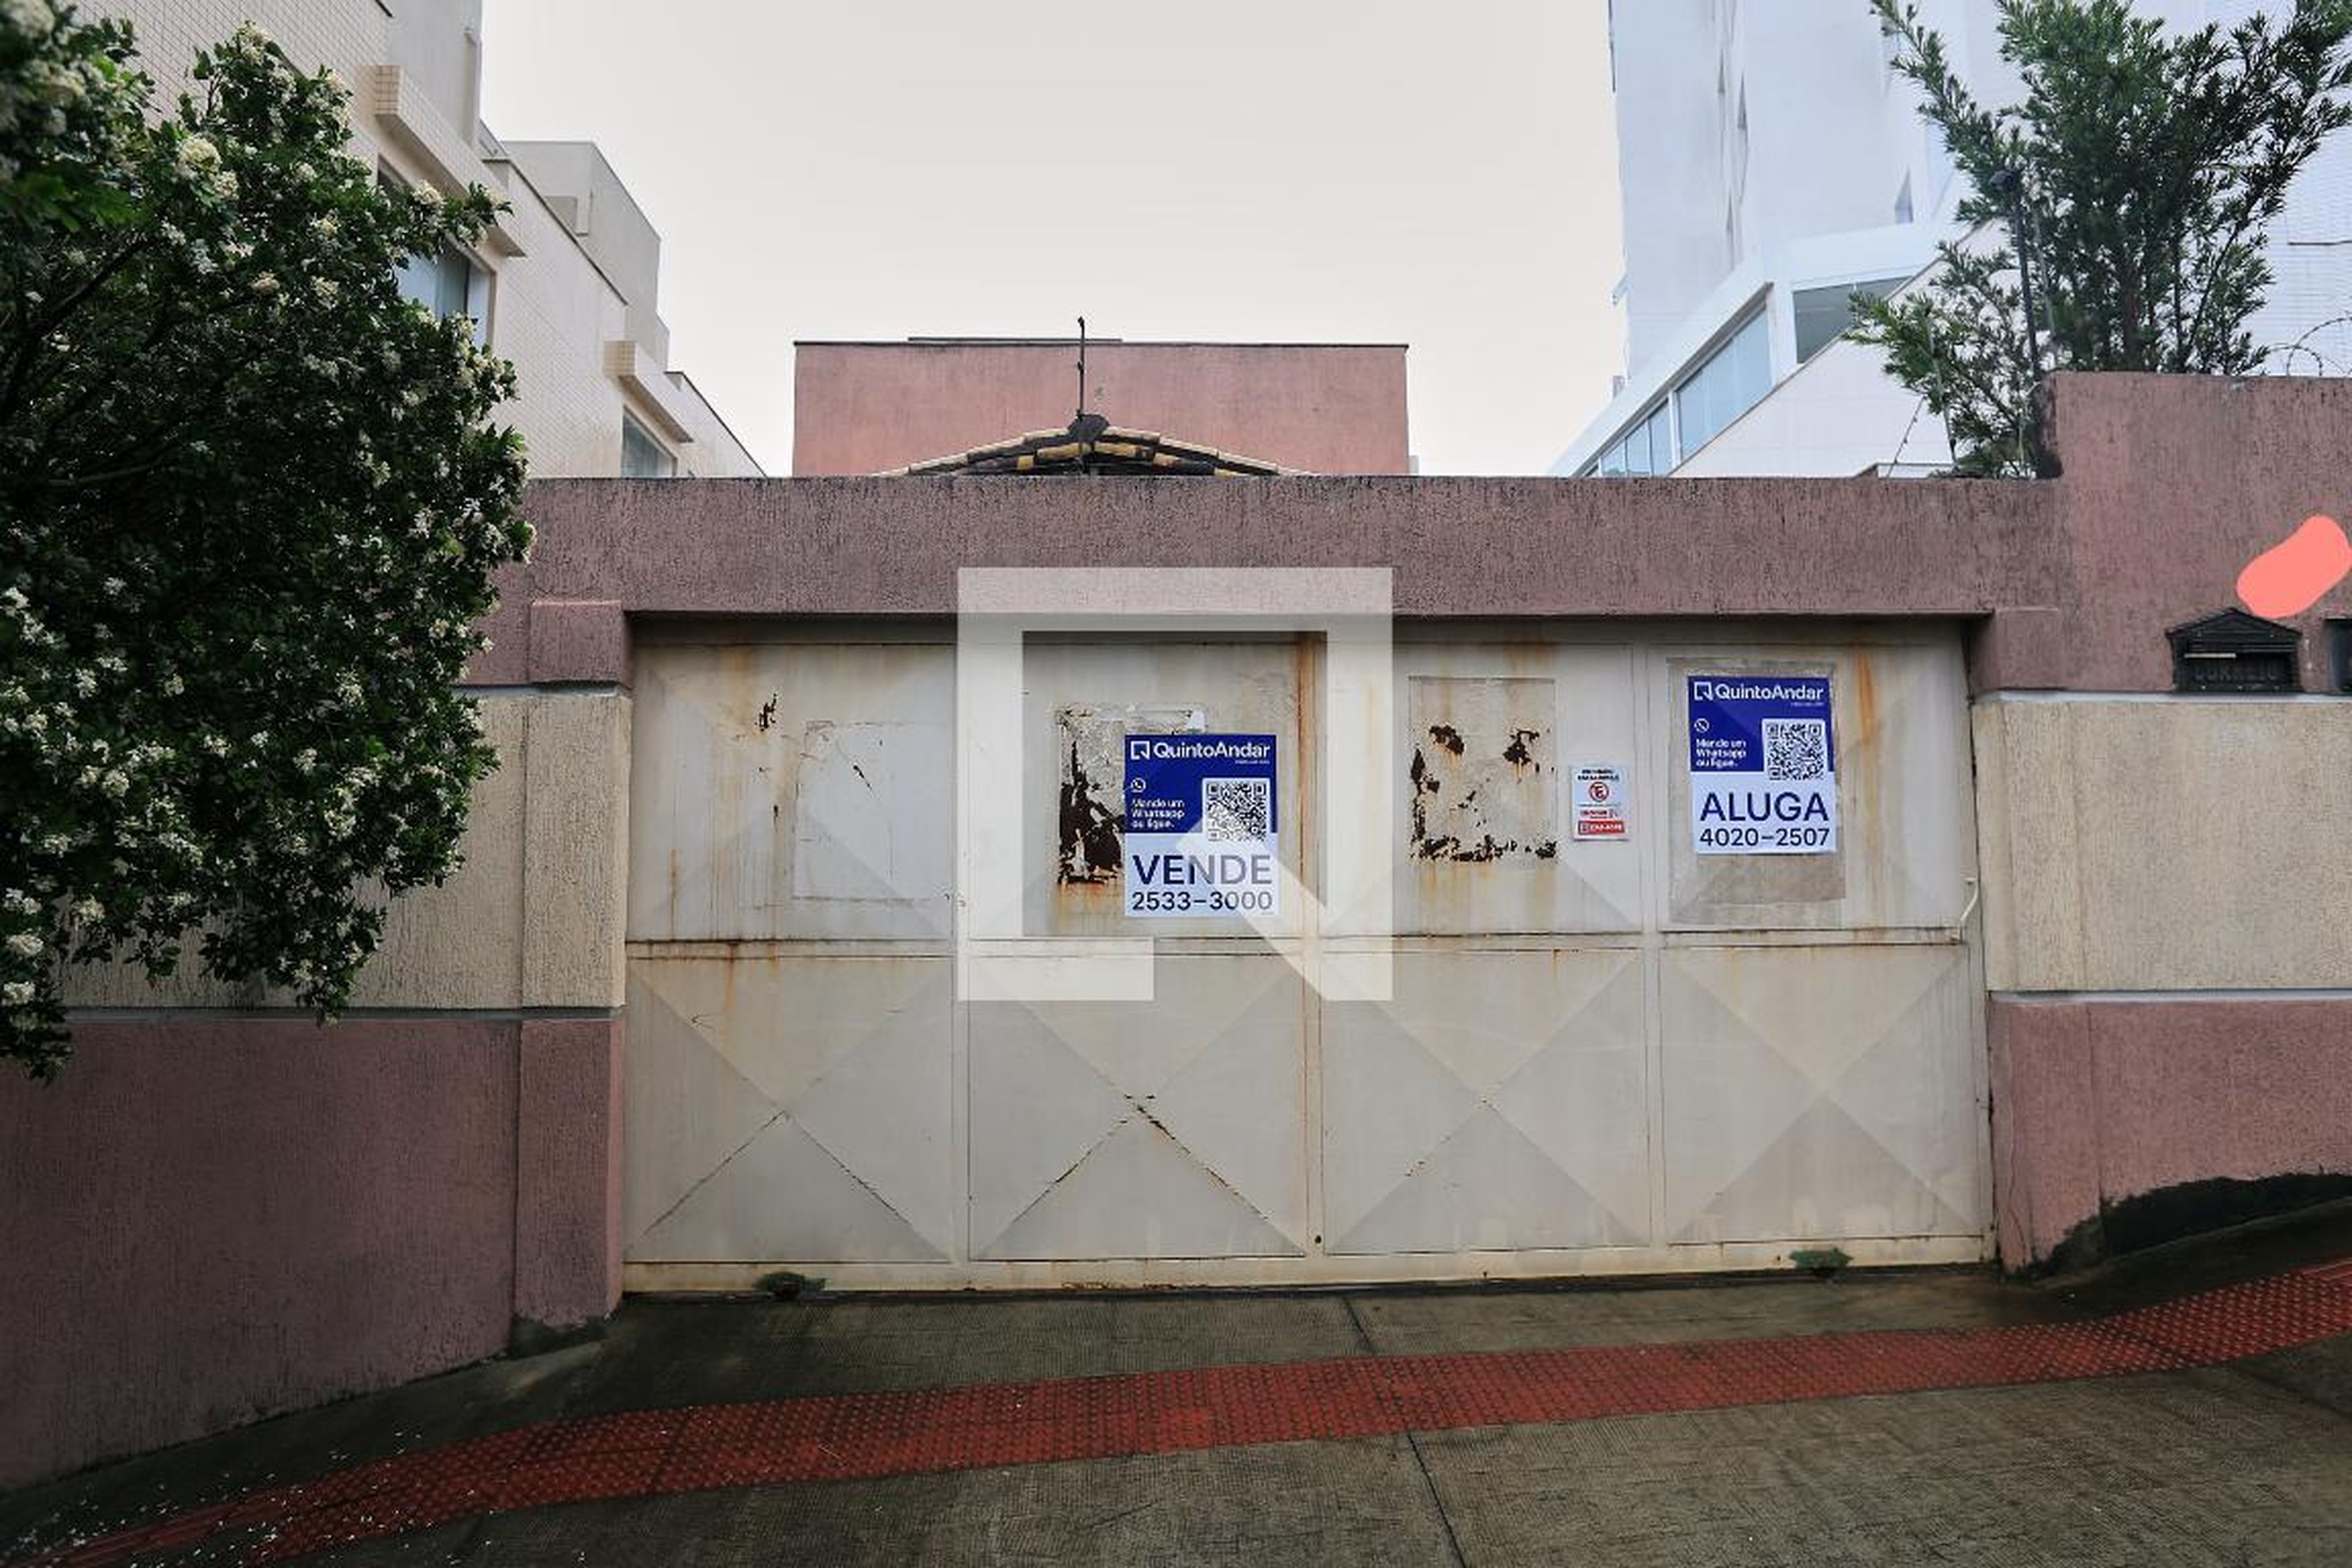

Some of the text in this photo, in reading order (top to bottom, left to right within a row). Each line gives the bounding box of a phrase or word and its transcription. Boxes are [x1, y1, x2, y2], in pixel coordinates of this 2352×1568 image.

[1716, 683, 1824, 701] QuintoAndar
[1153, 742, 1270, 758] QuintoAndar
[1700, 792, 1829, 821] ALUGA
[1700, 828, 1830, 846] 4020-2507
[1133, 855, 1272, 884] VENDE
[1133, 892, 1272, 910] 2533-3000
